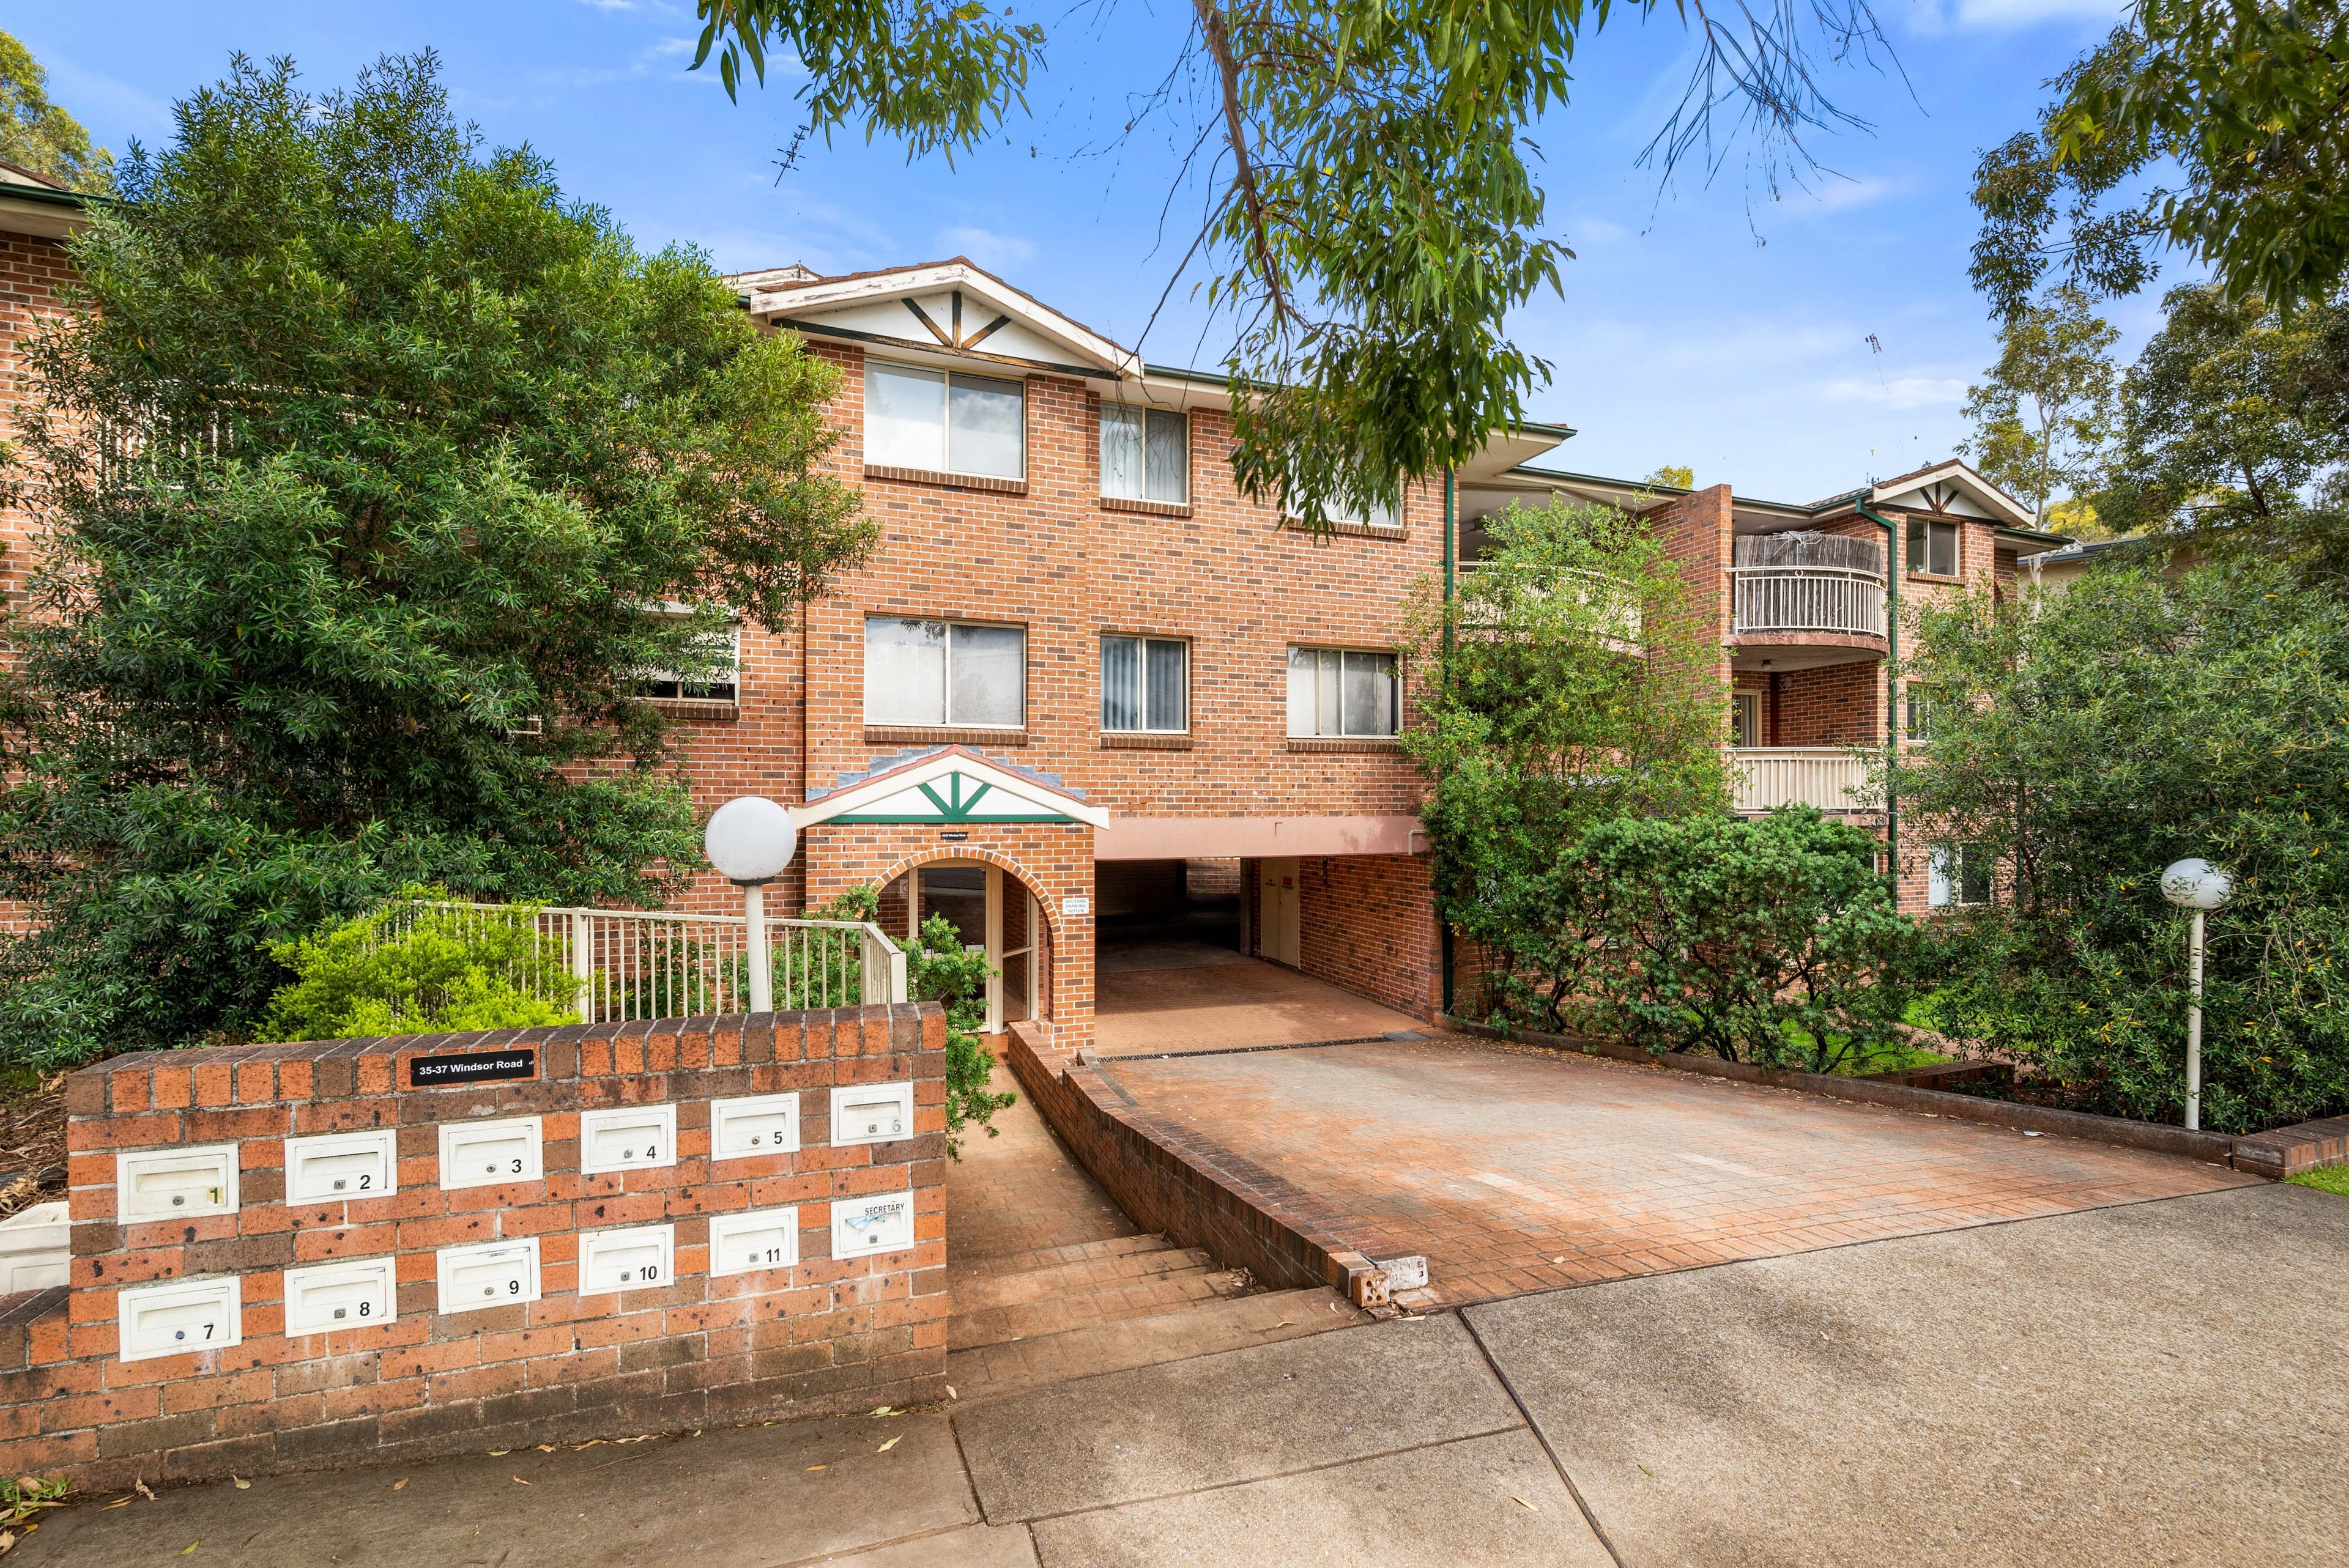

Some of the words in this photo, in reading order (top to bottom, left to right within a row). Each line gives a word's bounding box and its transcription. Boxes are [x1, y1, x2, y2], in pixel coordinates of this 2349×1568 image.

[419, 1065, 447, 1075] 35-37
[450, 1062, 494, 1073] Windsor
[496, 1059, 523, 1069] Road
[892, 1119, 901, 1133] 6
[774, 1131, 783, 1144] 5
[646, 1145, 656, 1159] 4
[511, 1159, 522, 1173] 3
[359, 1175, 371, 1189] 2
[210, 1187, 218, 1204] 1
[865, 1203, 905, 1216] SECRETARY
[766, 1248, 780, 1262] 11
[640, 1265, 658, 1281] 10
[509, 1280, 519, 1294] 9
[359, 1301, 370, 1316] 8
[203, 1323, 214, 1339] 7
